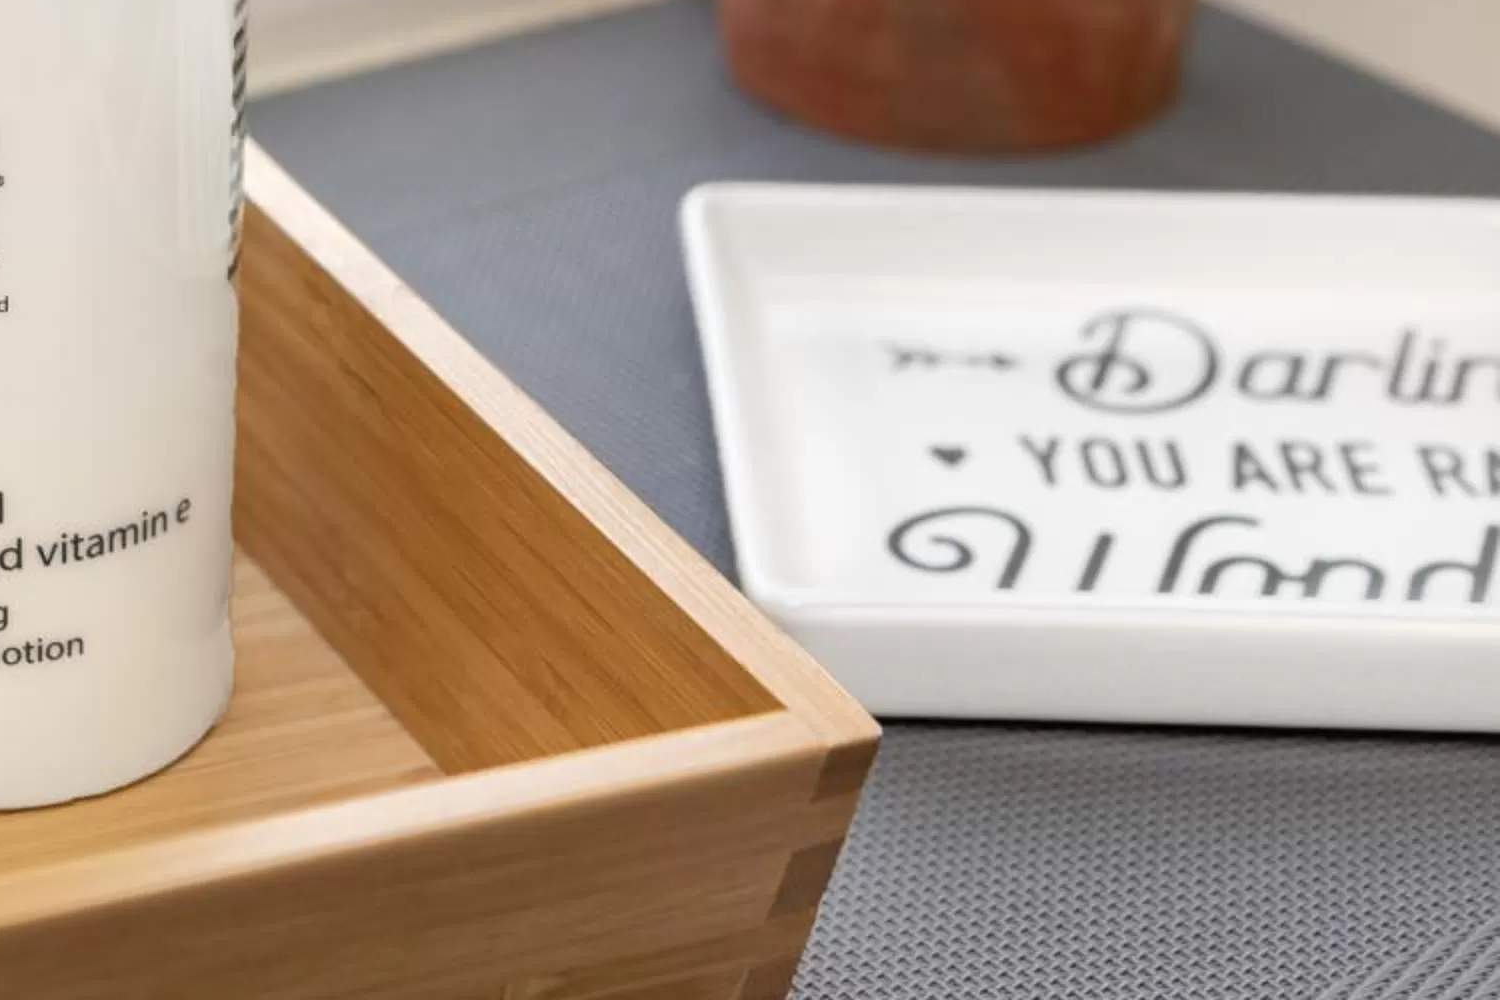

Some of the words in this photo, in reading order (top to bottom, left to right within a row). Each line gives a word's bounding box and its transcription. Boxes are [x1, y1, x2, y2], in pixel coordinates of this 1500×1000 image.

[1018, 435, 1190, 489] YOU
[1231, 439, 1394, 497] ARE
[36, 510, 168, 568] vitamin
[176, 498, 191, 524] e
